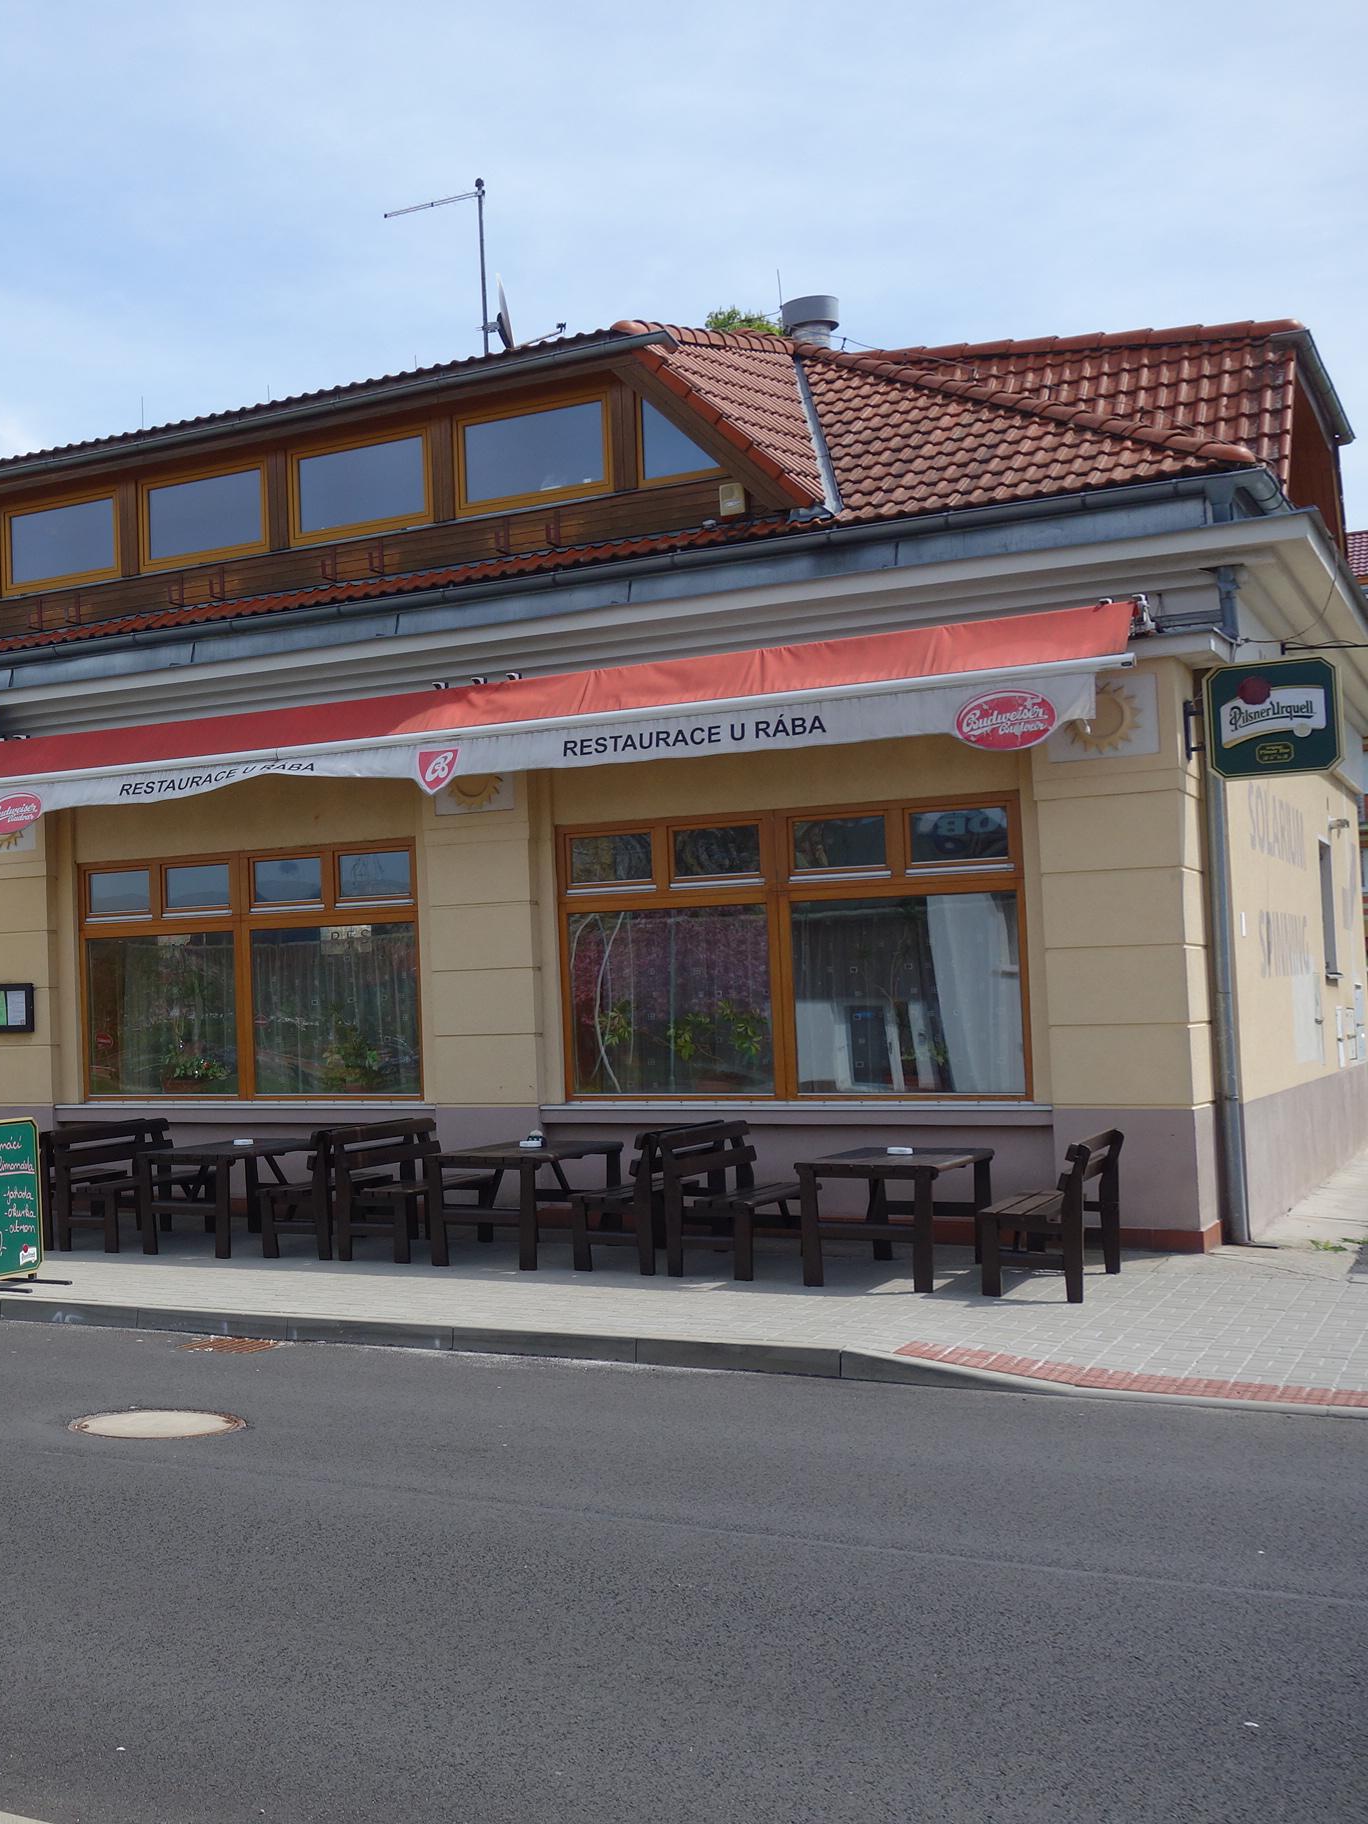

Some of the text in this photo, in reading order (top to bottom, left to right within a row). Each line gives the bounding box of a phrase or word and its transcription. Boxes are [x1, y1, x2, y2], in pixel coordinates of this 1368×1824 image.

[563, 714, 826, 757] RESTAURACE U RÁBA
[963, 706, 1045, 735] Budweiser
[119, 768, 236, 797] RESTAURACE
[242, 765, 255, 774] U
